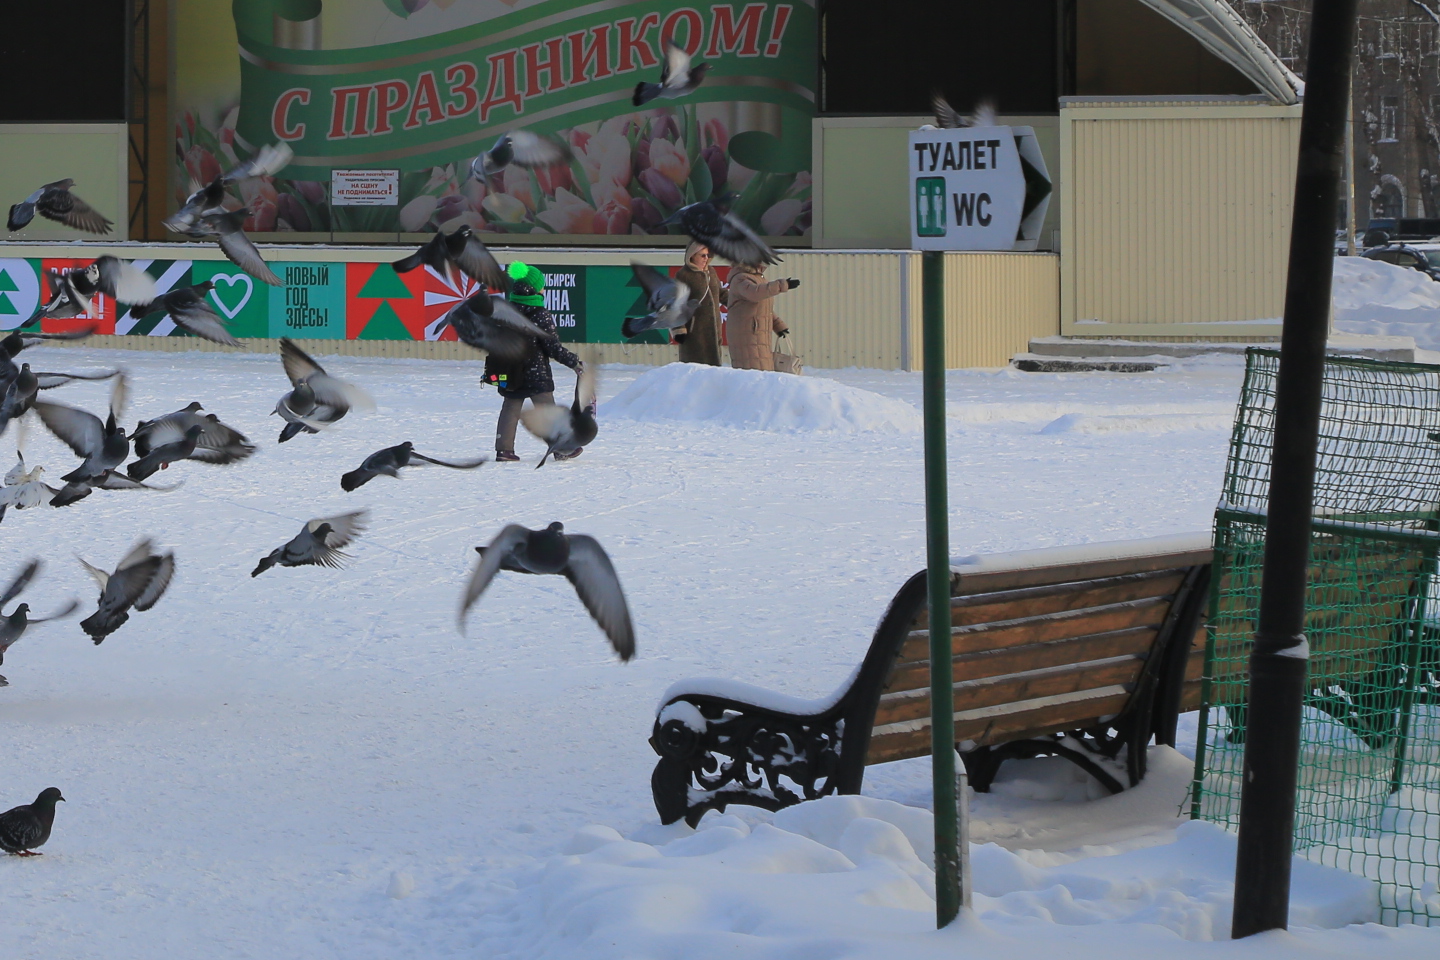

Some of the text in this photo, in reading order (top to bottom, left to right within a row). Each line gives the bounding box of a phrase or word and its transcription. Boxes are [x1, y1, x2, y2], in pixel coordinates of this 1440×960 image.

[271, 3, 793, 140] С ПРАЗДНИКОМ!
[914, 139, 1000, 172] ТУАЛЕТ
[953, 192, 993, 227] WC
[285, 264, 329, 286] НОВЫЙ
[543, 273, 576, 287] ИБИРСК
[285, 287, 309, 310] ГОД
[543, 289, 570, 311] ИНА
[286, 307, 328, 329] ЗДЕСЬ!
[559, 313, 576, 327] БАБ
